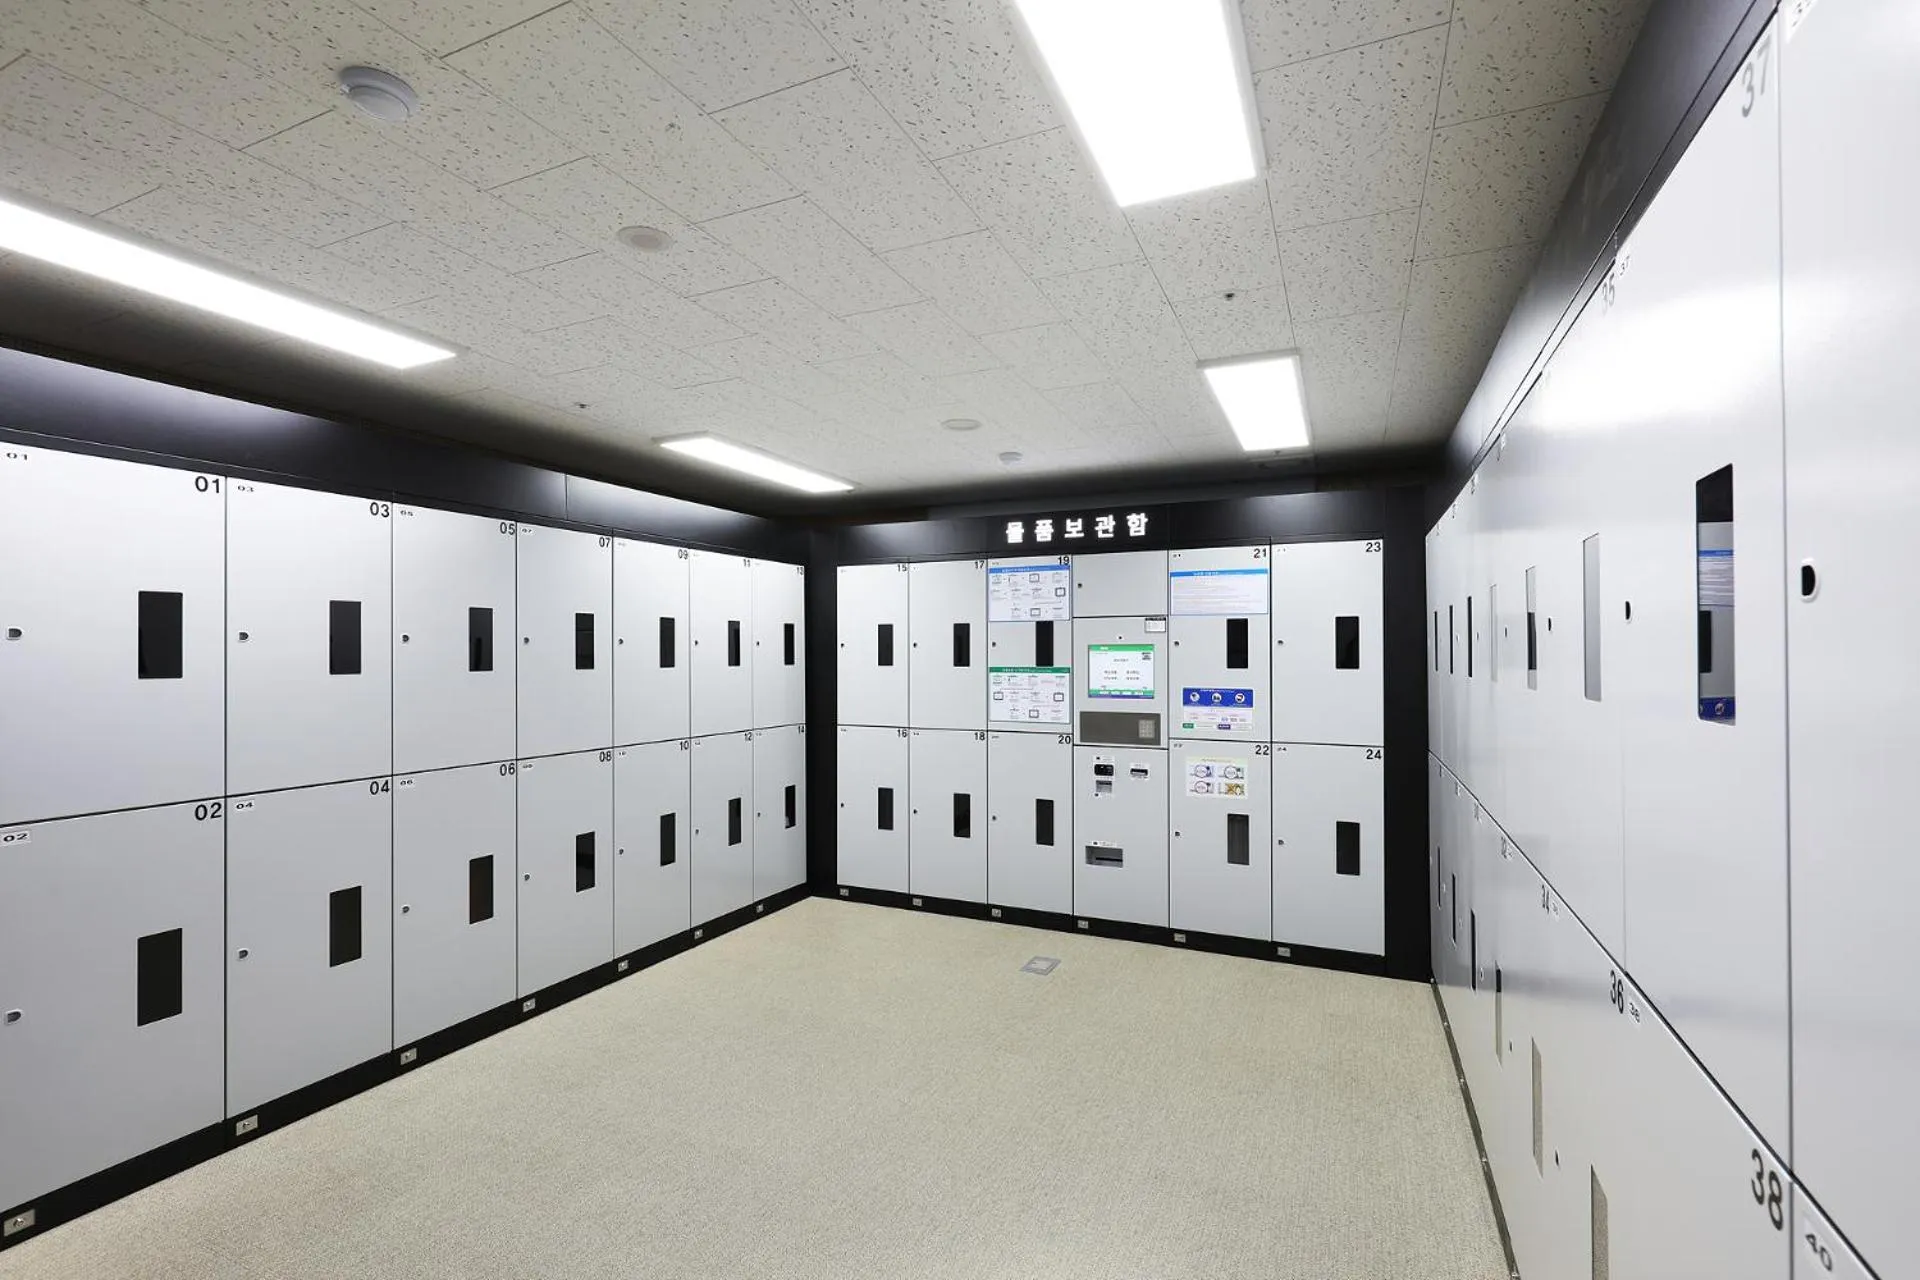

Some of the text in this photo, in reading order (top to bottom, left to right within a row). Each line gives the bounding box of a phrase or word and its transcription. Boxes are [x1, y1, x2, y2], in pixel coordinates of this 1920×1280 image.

[1742, 34, 1770, 118] 37
[7, 453, 28, 461] 01
[195, 476, 221, 493] 01
[238, 486, 254, 494] 03
[370, 501, 390, 517] 03
[499, 522, 515, 535] 05
[1006, 513, 1148, 543] 물품보관함
[599, 537, 611, 548] 07
[1366, 540, 1382, 552] 23
[678, 549, 688, 560] 09
[1253, 548, 1267, 559] 21
[743, 558, 751, 566] 11
[975, 559, 985, 569] 17
[1058, 555, 1071, 568] 19
[796, 566, 802, 576] 13
[897, 563, 907, 572] 15
[797, 724, 803, 734] 14
[897, 728, 908, 738] 16
[744, 731, 752, 740] 12
[975, 731, 985, 741] 18
[1059, 735, 1072, 745] 20
[678, 740, 688, 751] 10
[1255, 745, 1270, 757] 22
[599, 750, 611, 762] 08
[1366, 748, 1382, 759] 24
[499, 763, 515, 777] 06
[370, 779, 391, 795] 04
[237, 802, 253, 810] 04
[194, 803, 222, 821] 02
[3, 832, 28, 842] 02
[1610, 970, 1625, 1014] 36
[1750, 1148, 1784, 1232] 38
[1804, 1232, 1834, 1272] 40
